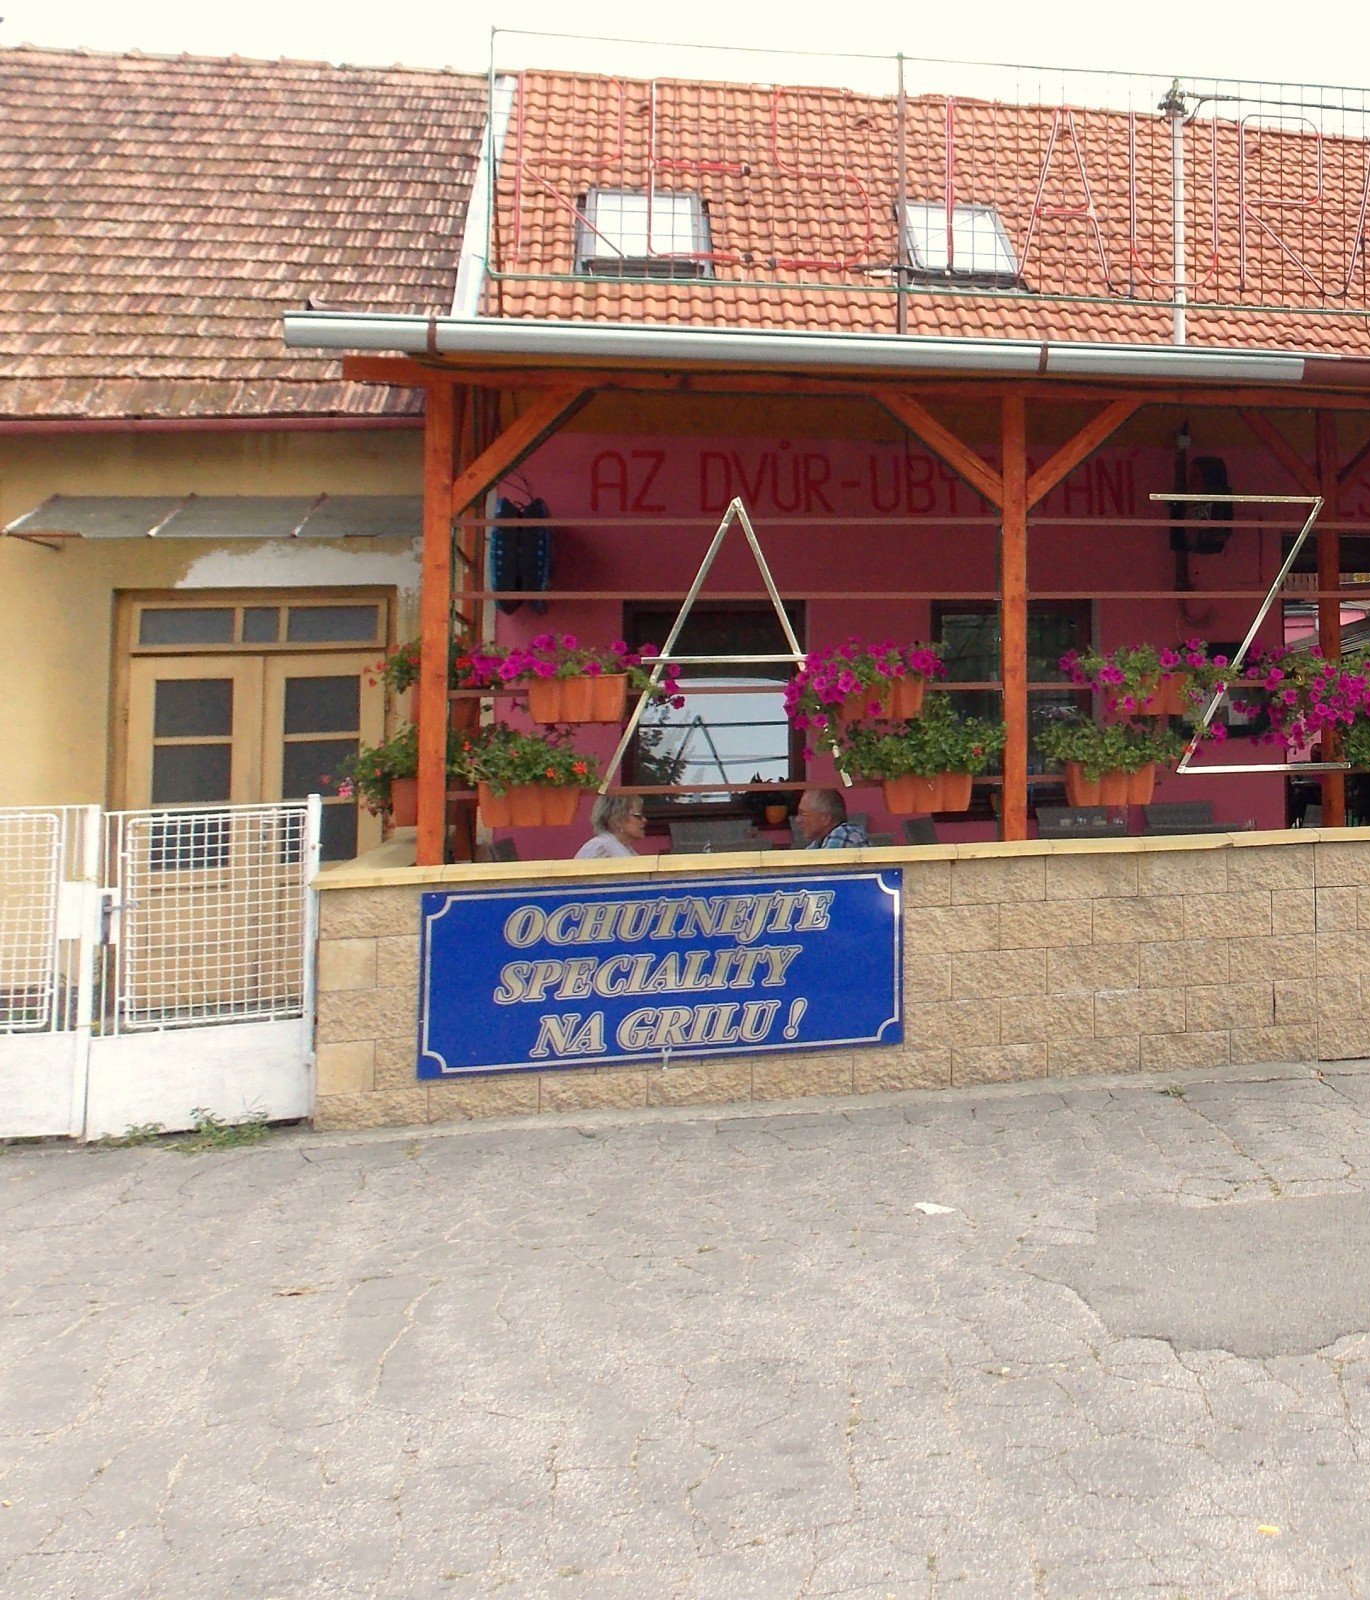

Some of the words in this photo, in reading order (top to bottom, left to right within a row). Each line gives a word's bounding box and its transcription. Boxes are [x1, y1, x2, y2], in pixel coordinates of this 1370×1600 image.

[590, 449, 666, 514] AZ
[504, 889, 835, 948] OCHUTNEJTE
[494, 944, 803, 1004] SPECIALITY
[529, 1010, 608, 1058] NA
